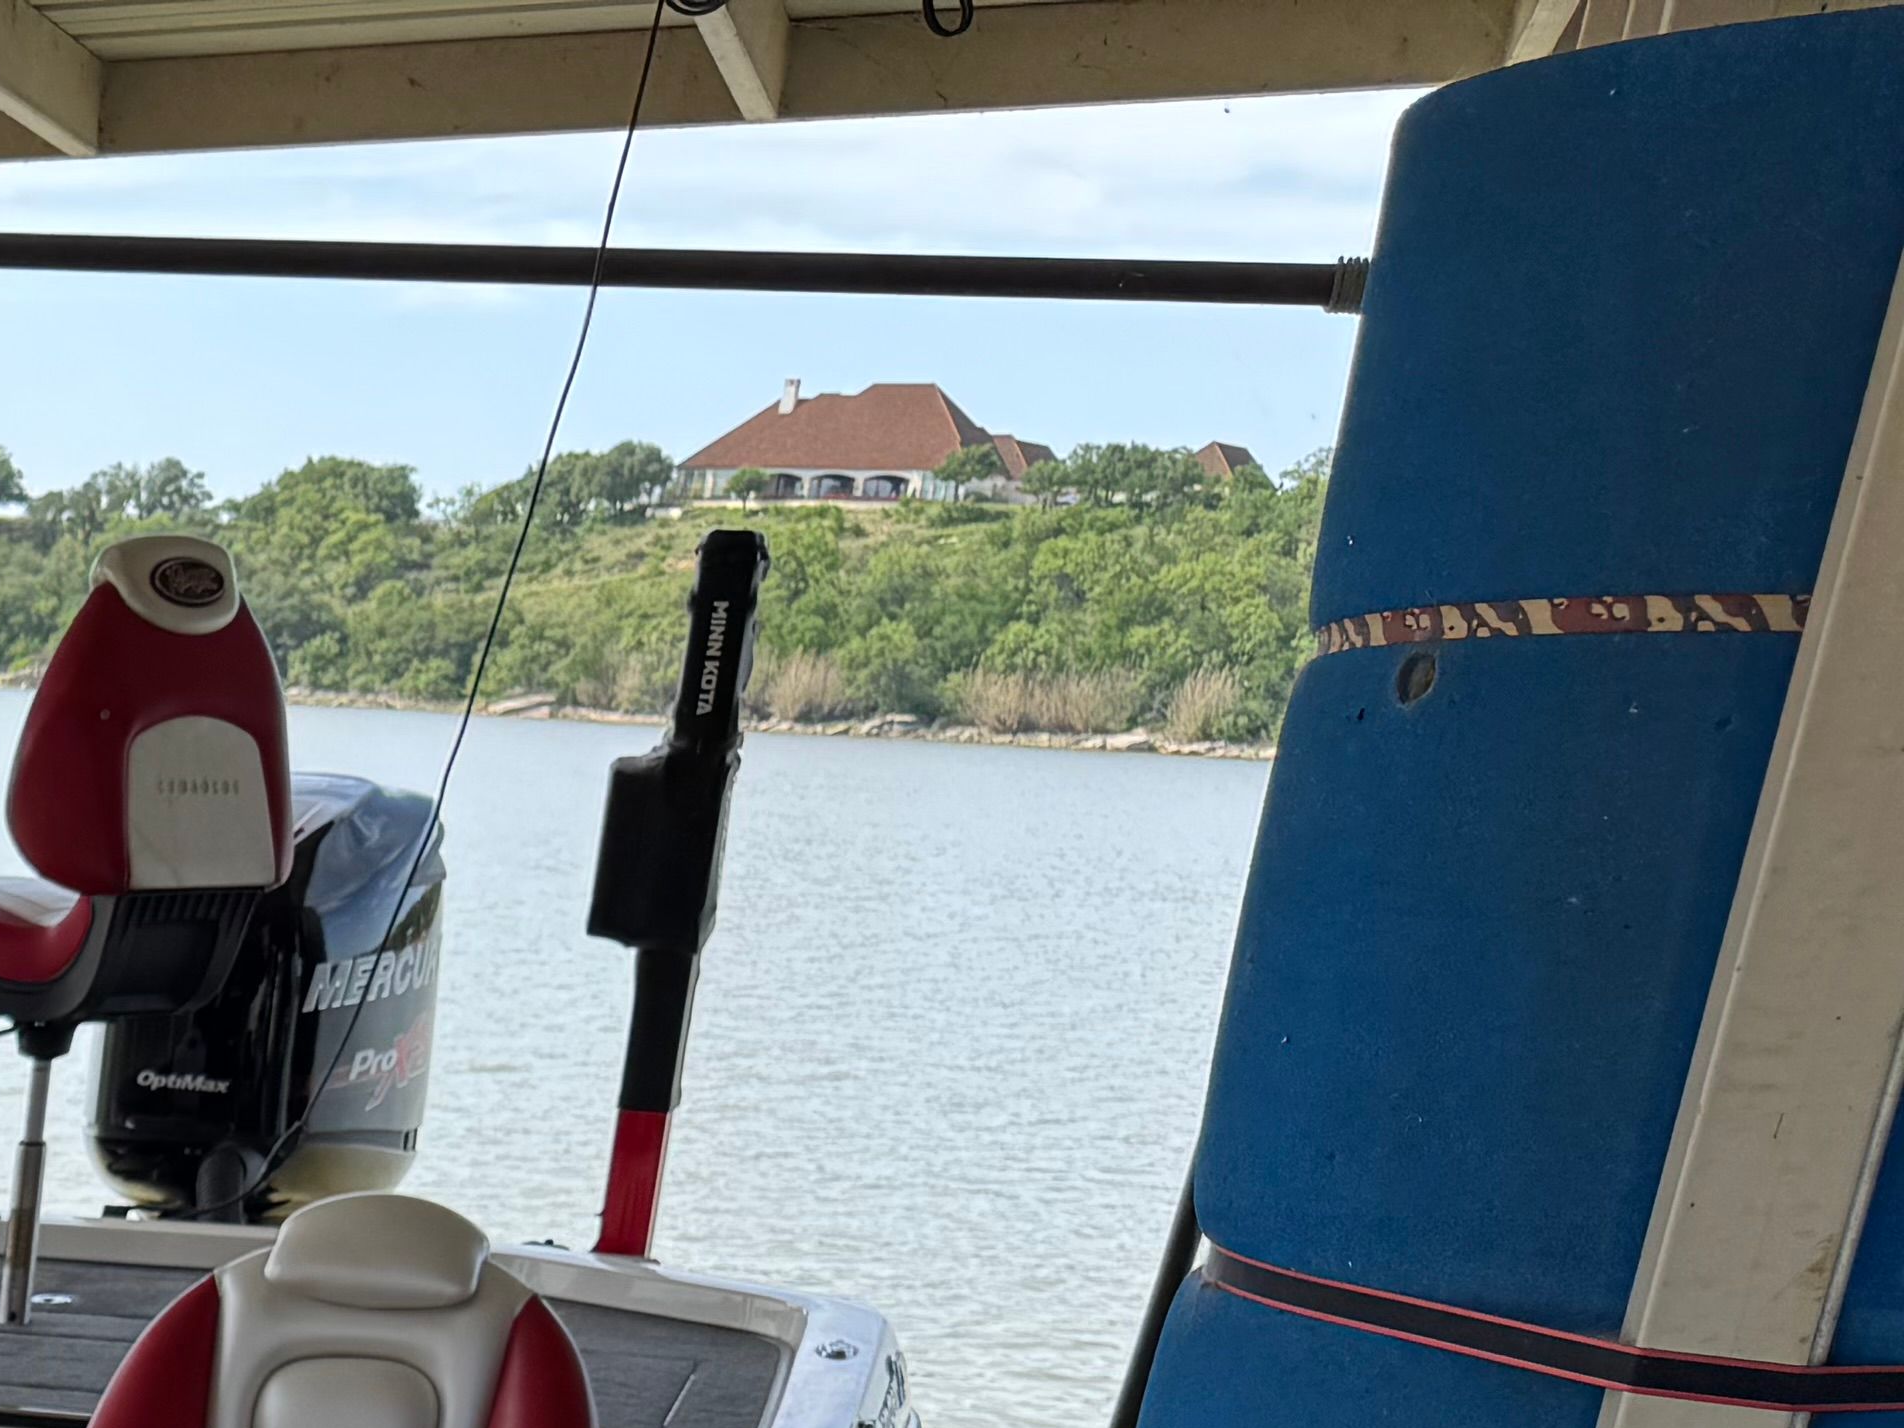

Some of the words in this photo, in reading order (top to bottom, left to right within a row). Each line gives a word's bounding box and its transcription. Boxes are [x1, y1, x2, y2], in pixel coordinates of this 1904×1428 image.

[705, 600, 729, 657] MINN
[696, 660, 720, 716] KOTA
[136, 1069, 231, 1095] OptiMax
